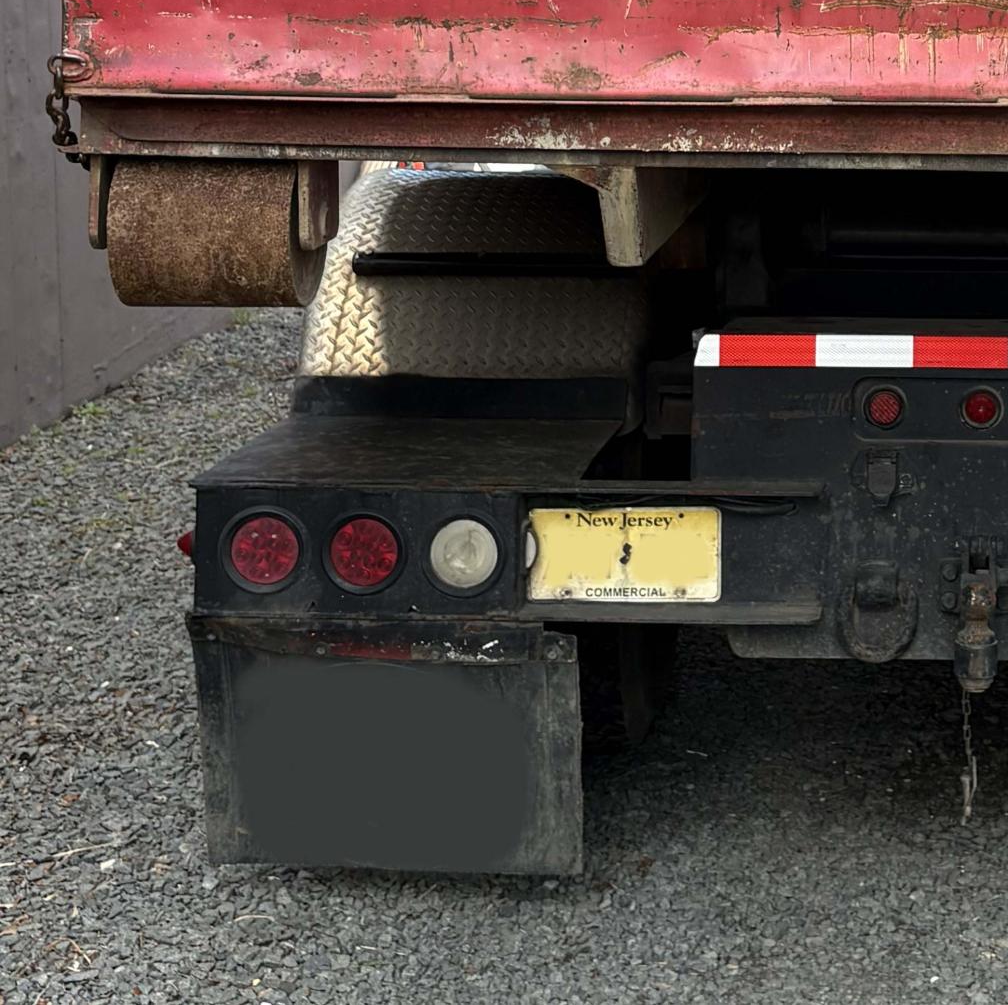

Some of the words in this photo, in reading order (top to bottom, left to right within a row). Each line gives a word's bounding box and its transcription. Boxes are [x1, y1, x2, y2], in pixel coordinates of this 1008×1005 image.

[576, 512, 617, 527] New
[619, 512, 673, 530] Jersey
[585, 587, 666, 597] COMMERCIAL
